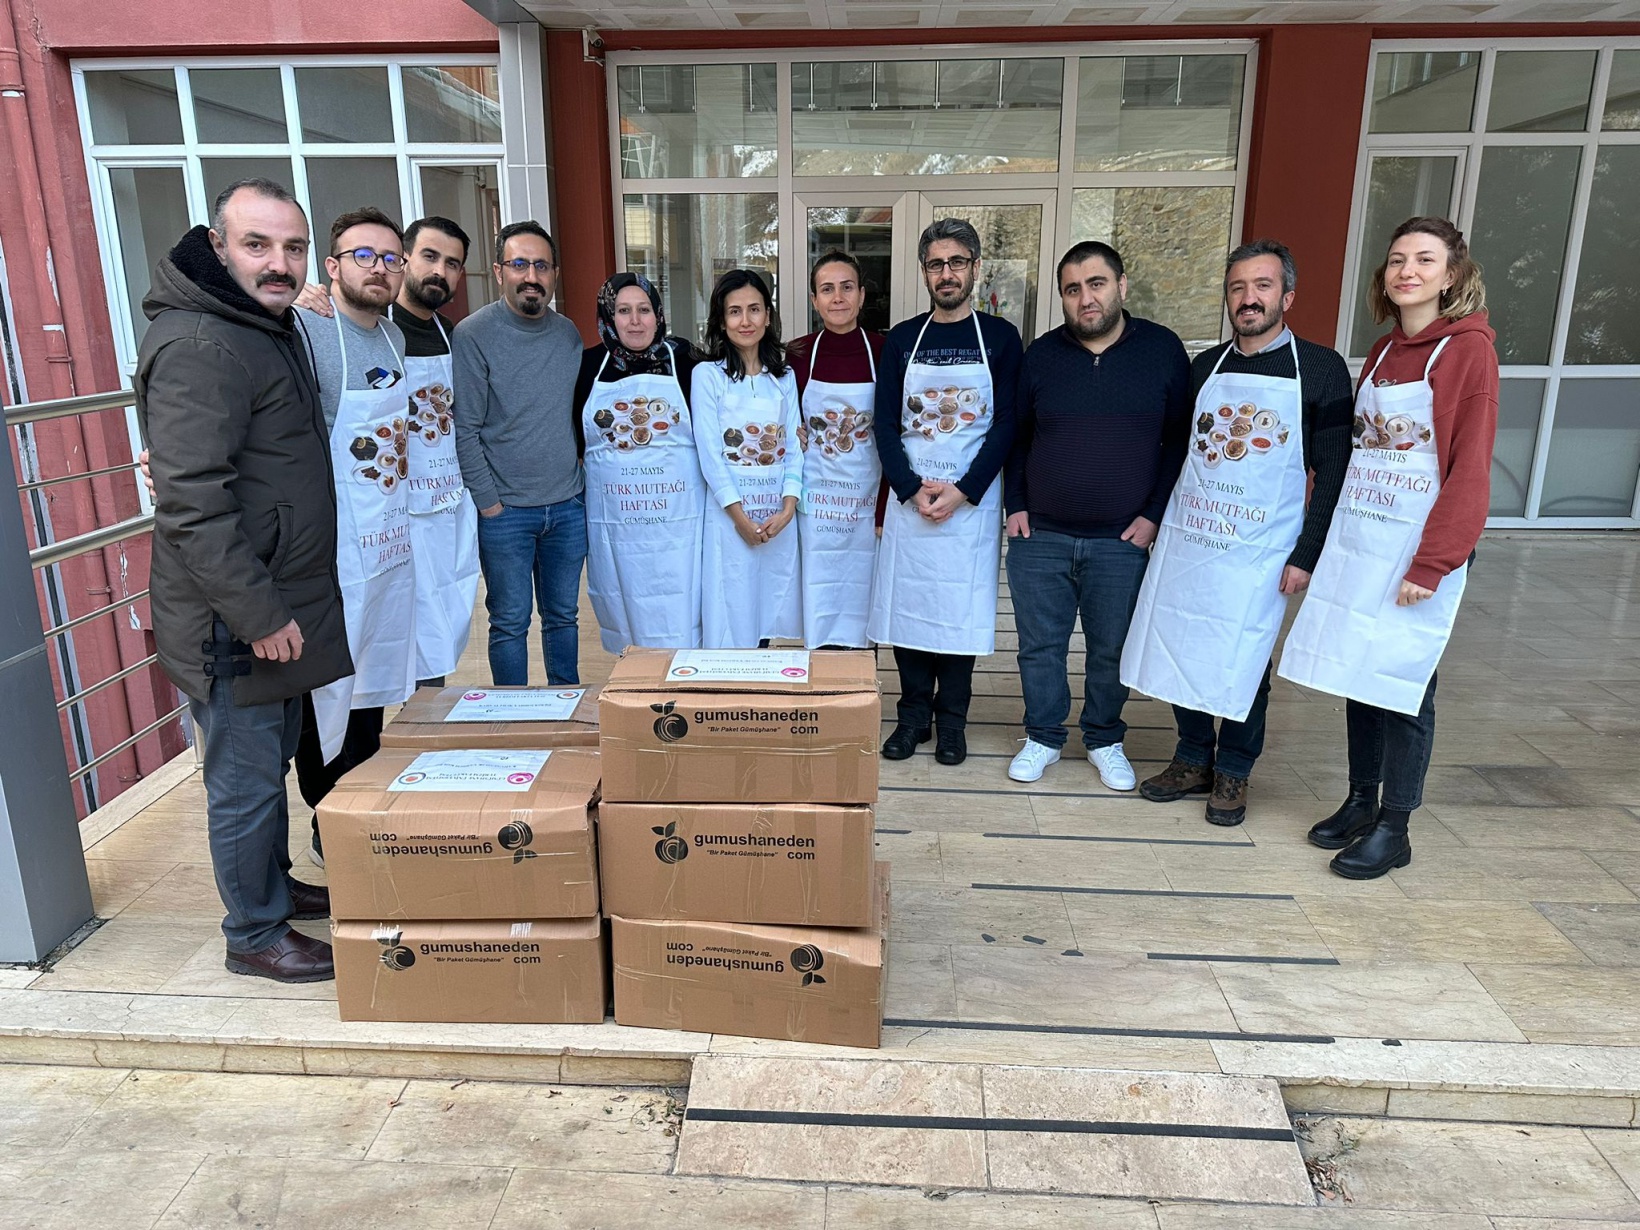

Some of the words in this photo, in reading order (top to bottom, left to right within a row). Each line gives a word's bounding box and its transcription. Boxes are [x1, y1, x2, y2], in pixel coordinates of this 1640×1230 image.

[941, 348, 957, 356] BEST
[916, 458, 932, 468] 21-27
[933, 460, 958, 470] MAYIS
[1379, 450, 1408, 464] MAYIS
[621, 467, 639, 476] 21-27
[640, 467, 665, 476] MAYIS
[409, 476, 441, 490] TÜRK
[604, 482, 632, 495] TÜRK
[634, 479, 686, 495] MUTFAĞI
[820, 480, 838, 488] 21-27
[838, 481, 861, 490] MAYIS
[1364, 468, 1432, 494] MUTFAĞI
[1215, 482, 1245, 496] MAYIS
[1345, 485, 1397, 507] HAFTASI
[620, 499, 667, 511] HAFTASI
[807, 491, 829, 505] ÜRK
[830, 494, 877, 508] MUTFAĞI
[1180, 492, 1203, 510] TÜRK
[1203, 499, 1266, 523] MUTFAĞI
[815, 508, 859, 522] HAFTASI
[1186, 514, 1237, 536] HAFTASI
[360, 530, 390, 548] TÜRK
[1184, 534, 1232, 551] GÜMÜŞHANE
[379, 542, 411, 563] HAFTAS
[694, 708, 819, 724] gumushaneden
[790, 725, 819, 734] com
[369, 833, 397, 841] com
[694, 833, 815, 848] gumushaneden
[372, 842, 493, 857] gumushaneden
[787, 851, 815, 860] com
[420, 941, 540, 955] gumushaneden
[666, 942, 693, 951] com
[741, 948, 759, 957] Paket
[513, 956, 541, 964] com
[666, 954, 785, 973] gumushaneden
